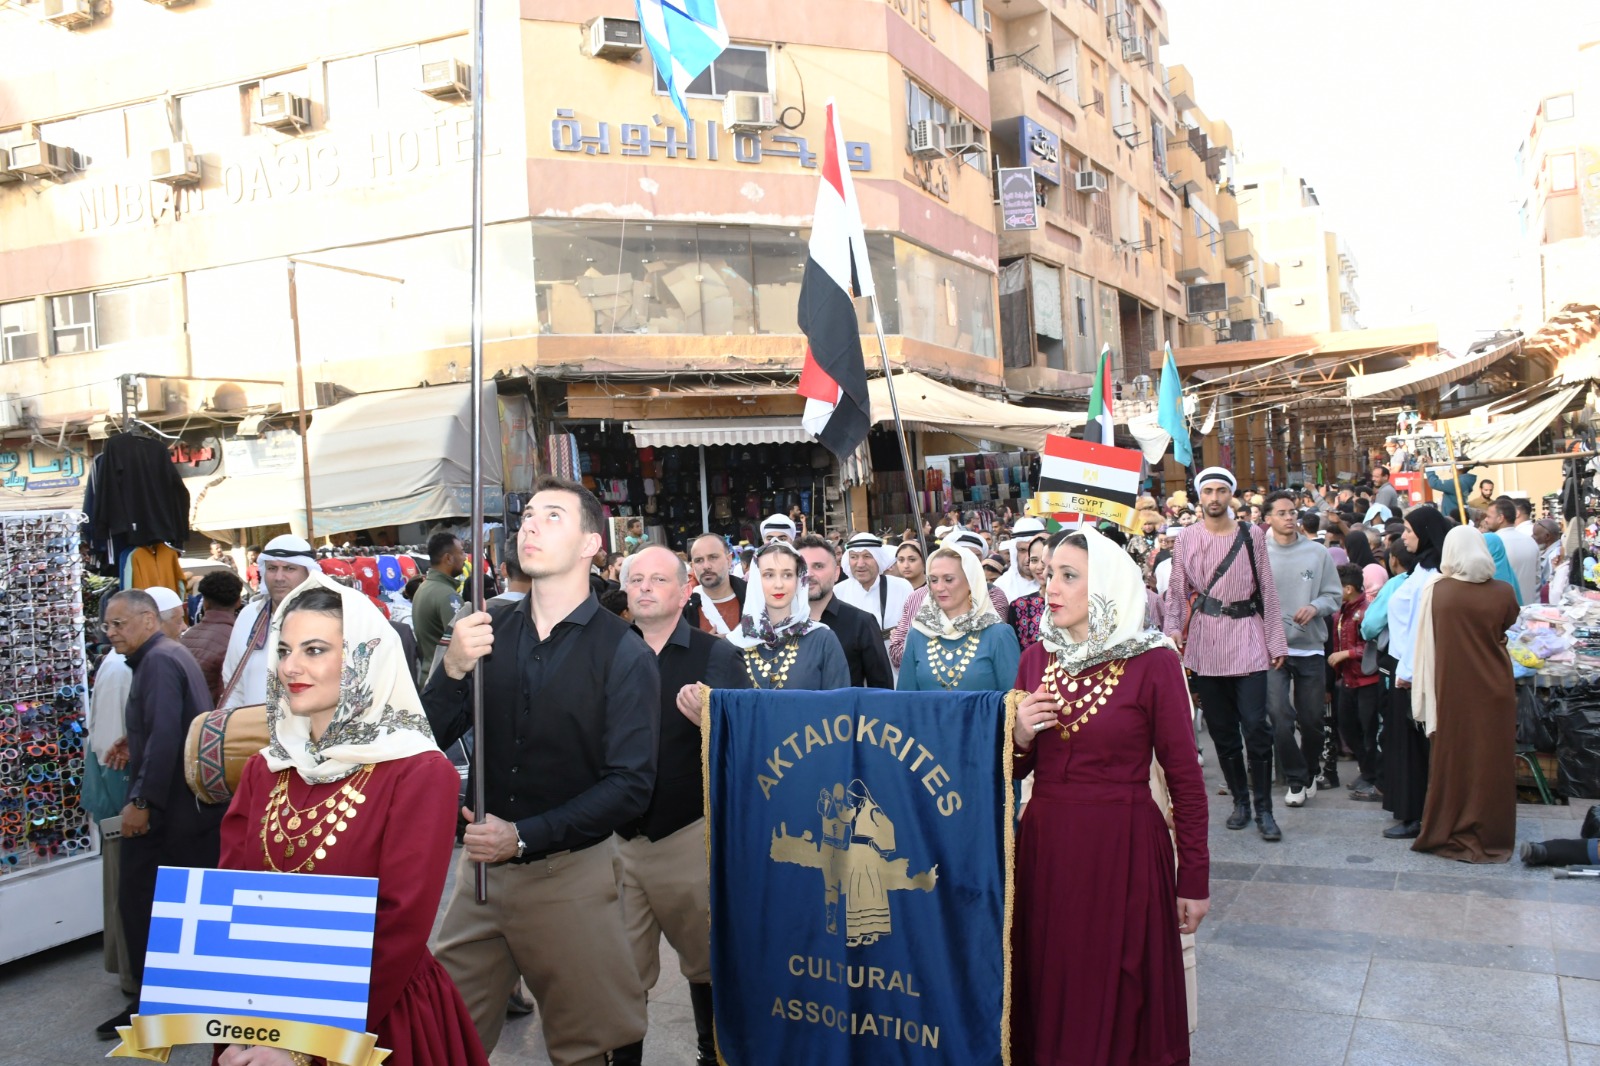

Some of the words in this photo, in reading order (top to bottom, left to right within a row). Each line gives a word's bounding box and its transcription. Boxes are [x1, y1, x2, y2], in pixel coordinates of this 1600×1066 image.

[224, 144, 341, 206] OASIS
[1071, 496, 1105, 509] EGYPT
[757, 714, 963, 818] AKTAIOKRITES
[788, 954, 921, 998] CULTURAL
[205, 1018, 281, 1044] Greece
[771, 996, 941, 1049] ASSOCIATION
